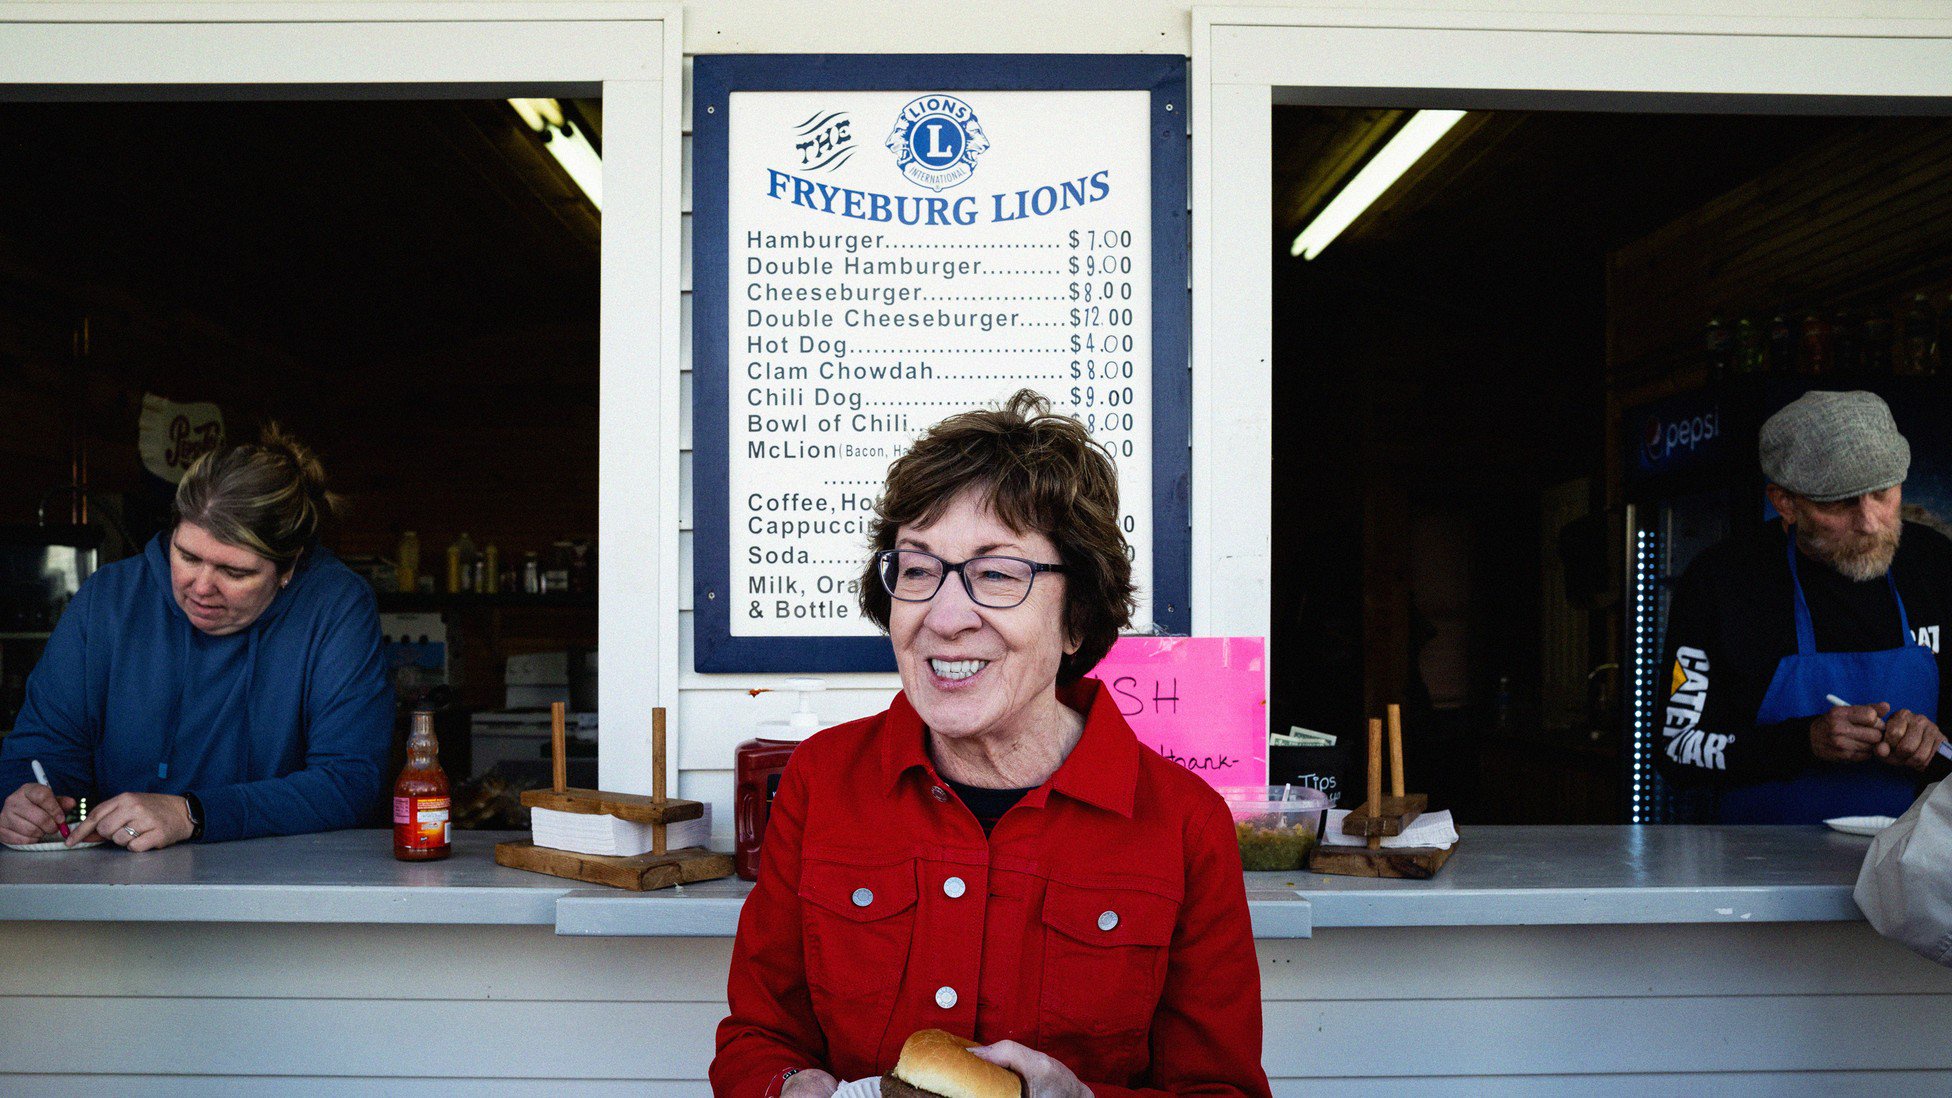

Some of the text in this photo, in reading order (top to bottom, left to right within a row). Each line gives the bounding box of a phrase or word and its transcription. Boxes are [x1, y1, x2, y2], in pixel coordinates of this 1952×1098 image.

[908, 98, 967, 119] LIONS
[795, 118, 853, 166] THE
[926, 124, 953, 158] L
[908, 166, 967, 184] INTERNATIONAL
[766, 167, 1110, 226] FRYEBURG LIONS
[747, 230, 885, 254] Hamburger
[747, 256, 833, 275] Double
[844, 256, 982, 280] Hamburger
[747, 282, 922, 306] Cheeseburger
[747, 309, 833, 328] Double
[844, 308, 1020, 332] Cheeseburger
[747, 335, 789, 354] Hot
[799, 335, 846, 359] Dog
[747, 361, 808, 380] Clam
[819, 361, 933, 380] Chowdah
[747, 387, 803, 407] Chili
[815, 387, 862, 411] Dog
[748, 414, 807, 433] Bowl
[818, 413, 842, 433] of
[851, 413, 907, 433] Chili
[1665, 406, 1720, 457] pepsi
[748, 440, 836, 459] McLion
[747, 492, 873, 515] Coffee, Ho
[748, 545, 809, 565] Soda
[748, 575, 860, 598] Milk, Ora
[748, 599, 849, 619] & Bottle
[1112, 676, 1179, 716] SH
[1297, 772, 1337, 793] Tips
